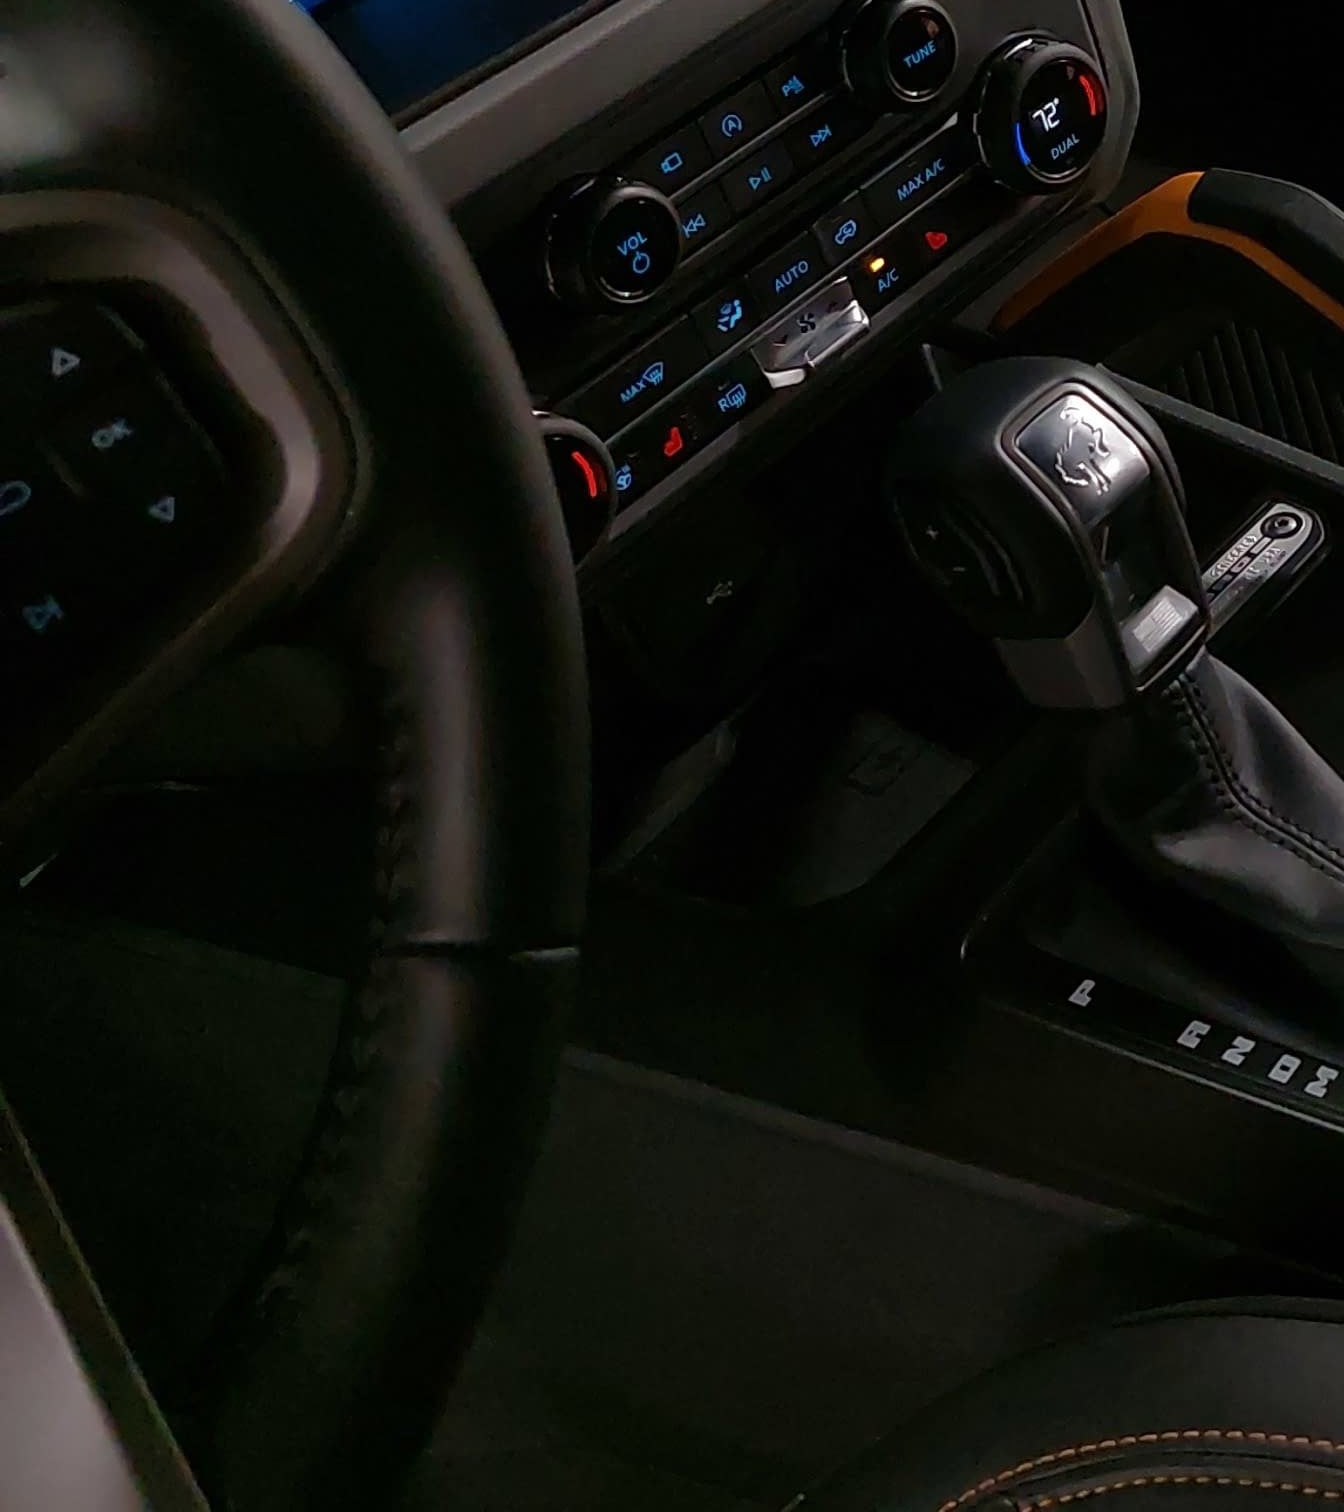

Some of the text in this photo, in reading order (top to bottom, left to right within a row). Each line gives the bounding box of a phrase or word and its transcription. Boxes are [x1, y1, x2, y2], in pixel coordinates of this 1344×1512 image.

[903, 39, 937, 69] TUNE
[1050, 133, 1080, 161] DUAL
[897, 157, 946, 201] MAX A/C
[617, 231, 648, 257] VOL
[773, 260, 809, 294] AUTO
[877, 268, 900, 293] A/C
[620, 379, 646, 404] MAX
[91, 417, 132, 449] OK
[1068, 979, 1096, 1007] P
